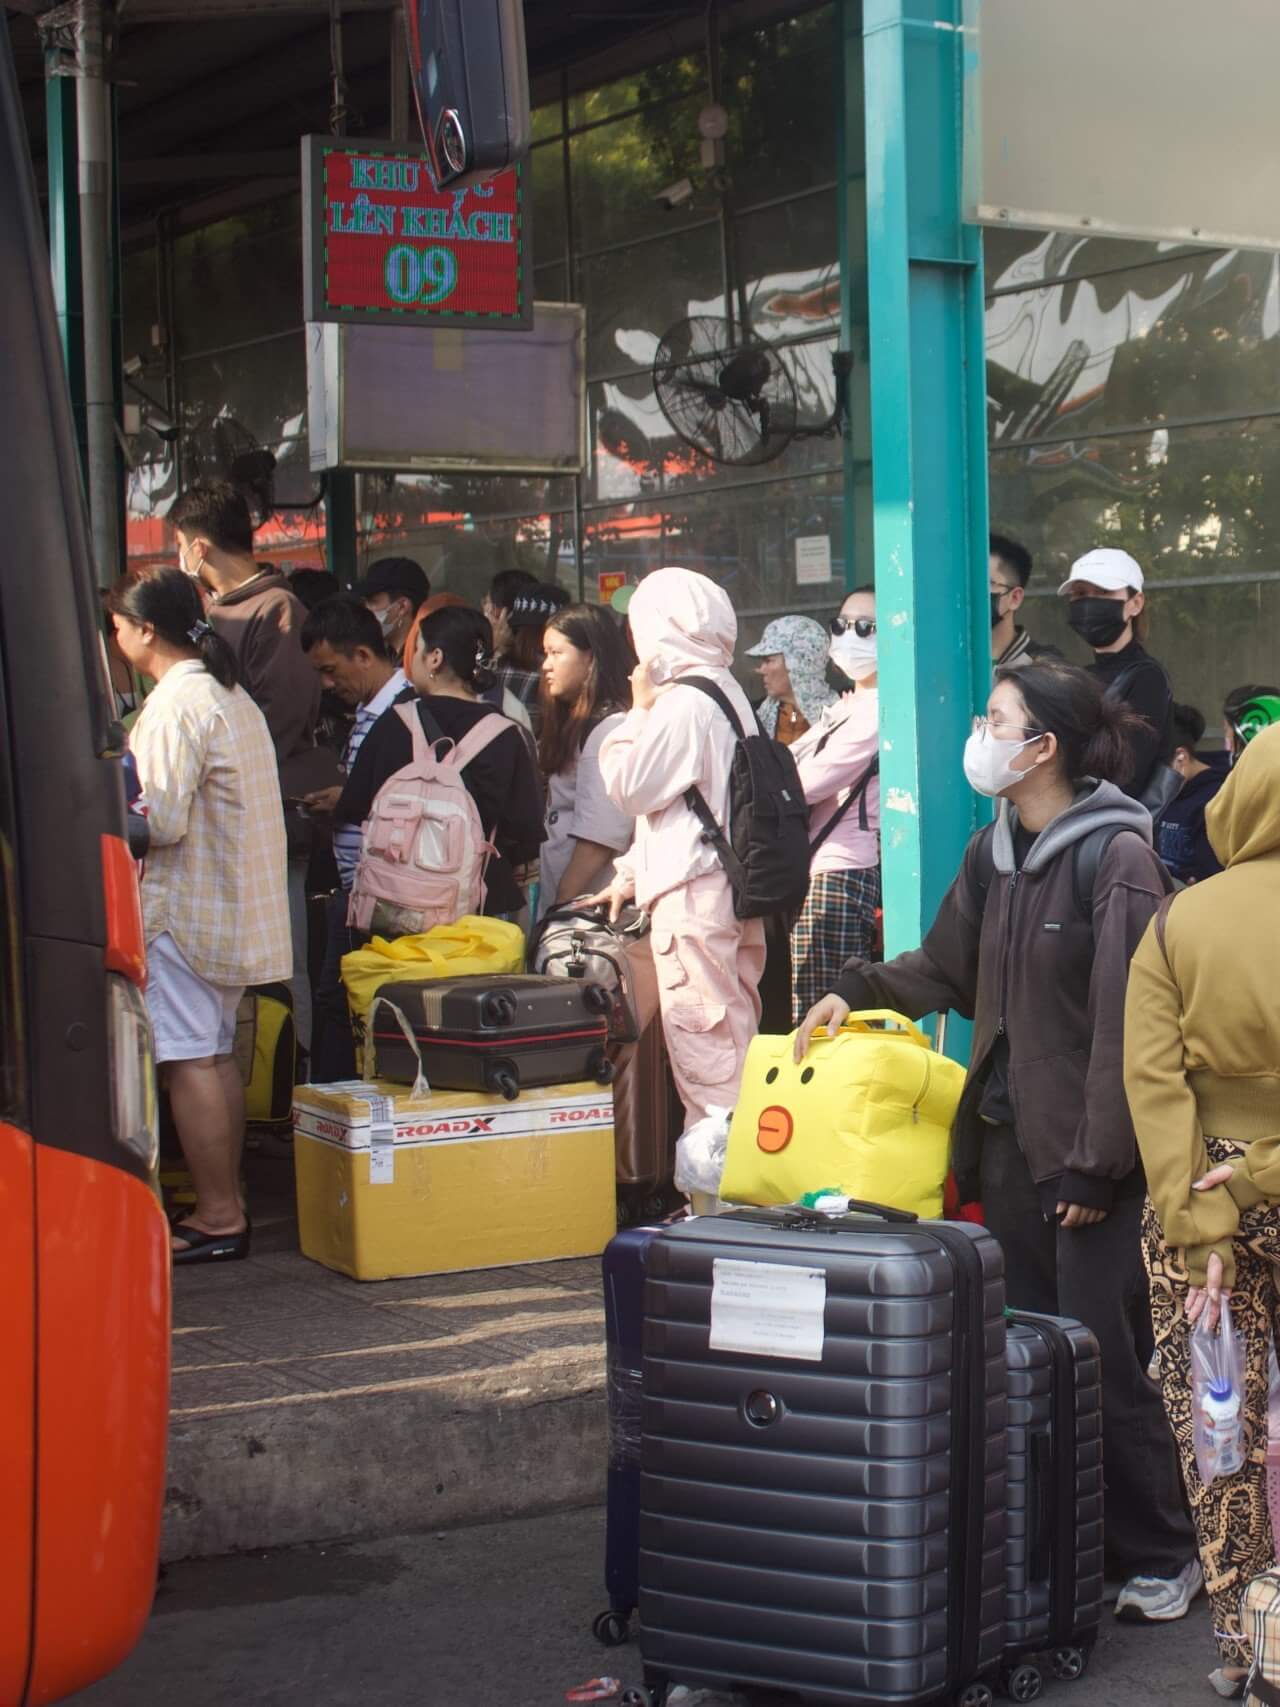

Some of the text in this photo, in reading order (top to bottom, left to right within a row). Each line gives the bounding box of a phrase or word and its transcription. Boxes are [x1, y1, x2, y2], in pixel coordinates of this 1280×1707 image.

[350, 158, 420, 192] KHU
[330, 191, 514, 243] LÊN KHÁCH
[384, 244, 459, 304] 09
[396, 1117, 497, 1138] ROADX
